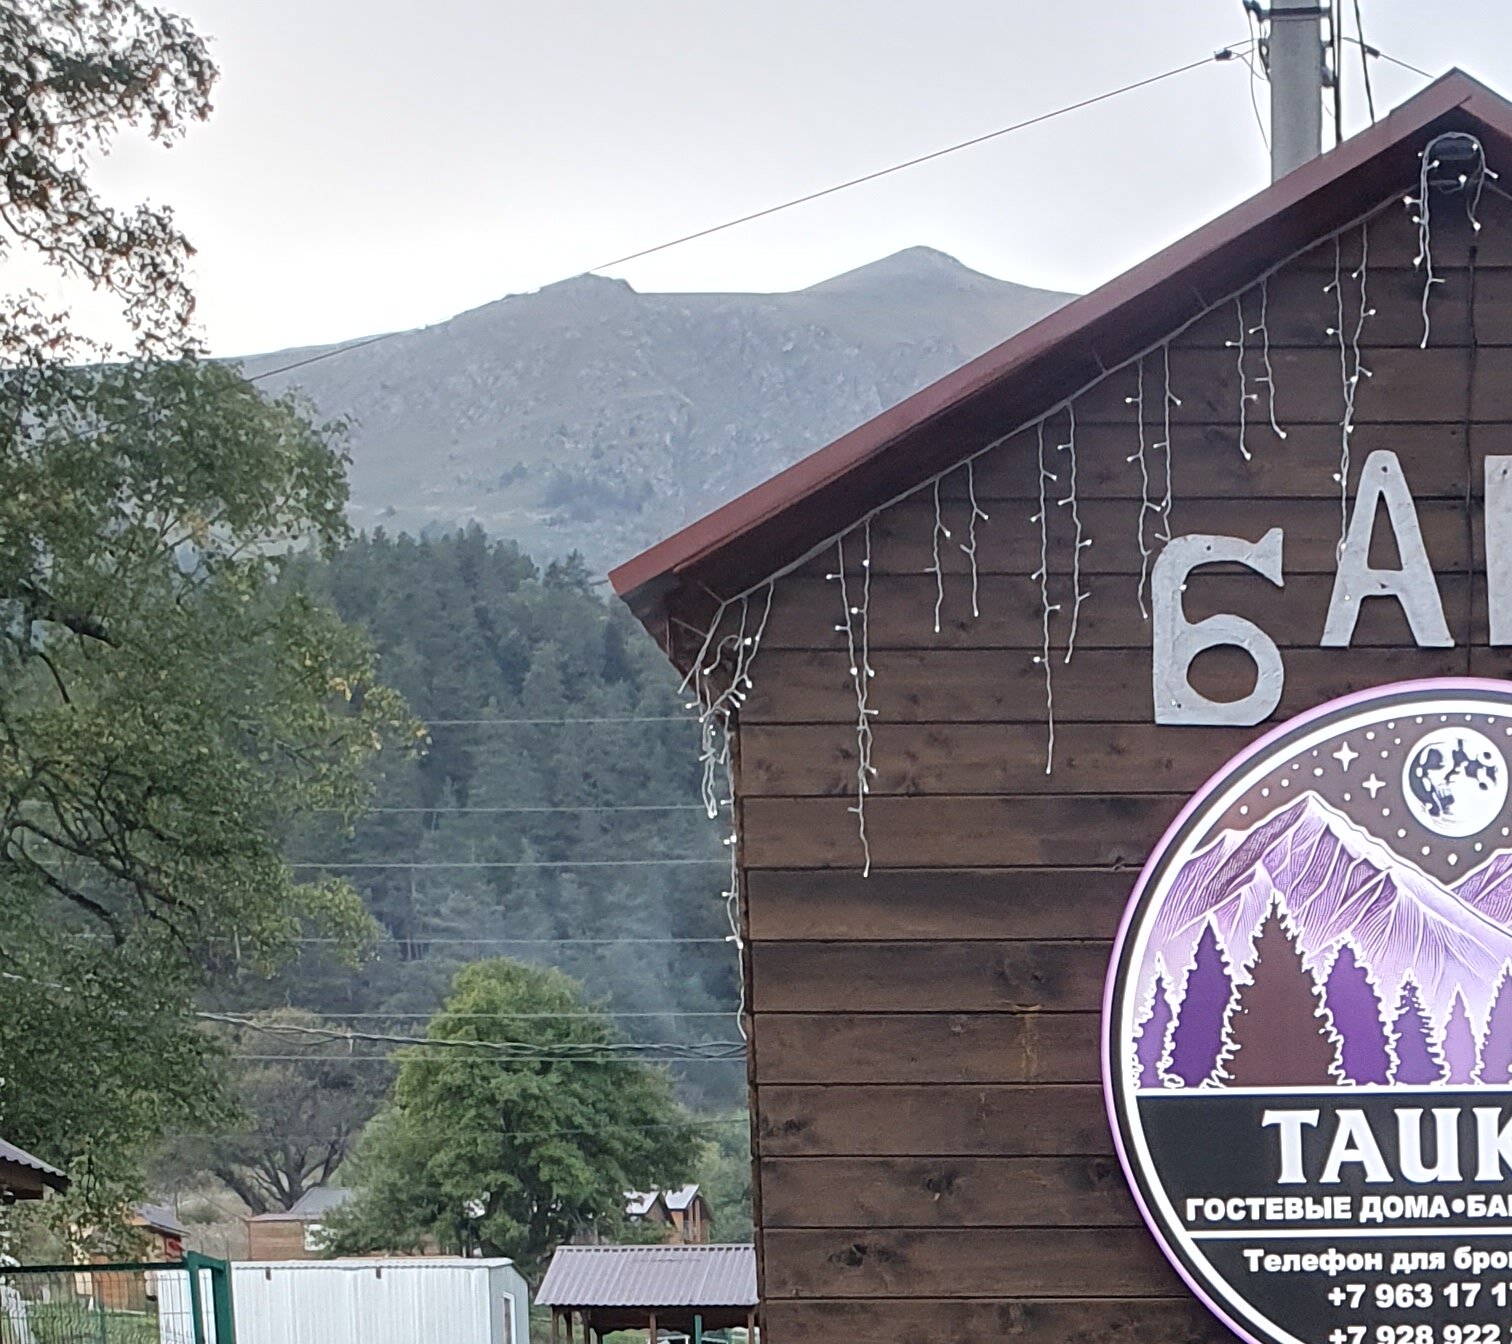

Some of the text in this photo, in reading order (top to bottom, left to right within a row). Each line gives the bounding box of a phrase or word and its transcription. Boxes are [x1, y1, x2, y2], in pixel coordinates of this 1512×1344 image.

[1186, 1195, 1352, 1222] ГОСТЕВЫЕ
[1243, 1247, 1383, 1276] Телефон
[1390, 1251, 1446, 1274] для
[1327, 1283, 1366, 1309] +7
[1374, 1282, 1434, 1308] 963
[1443, 1282, 1482, 1307] 17
